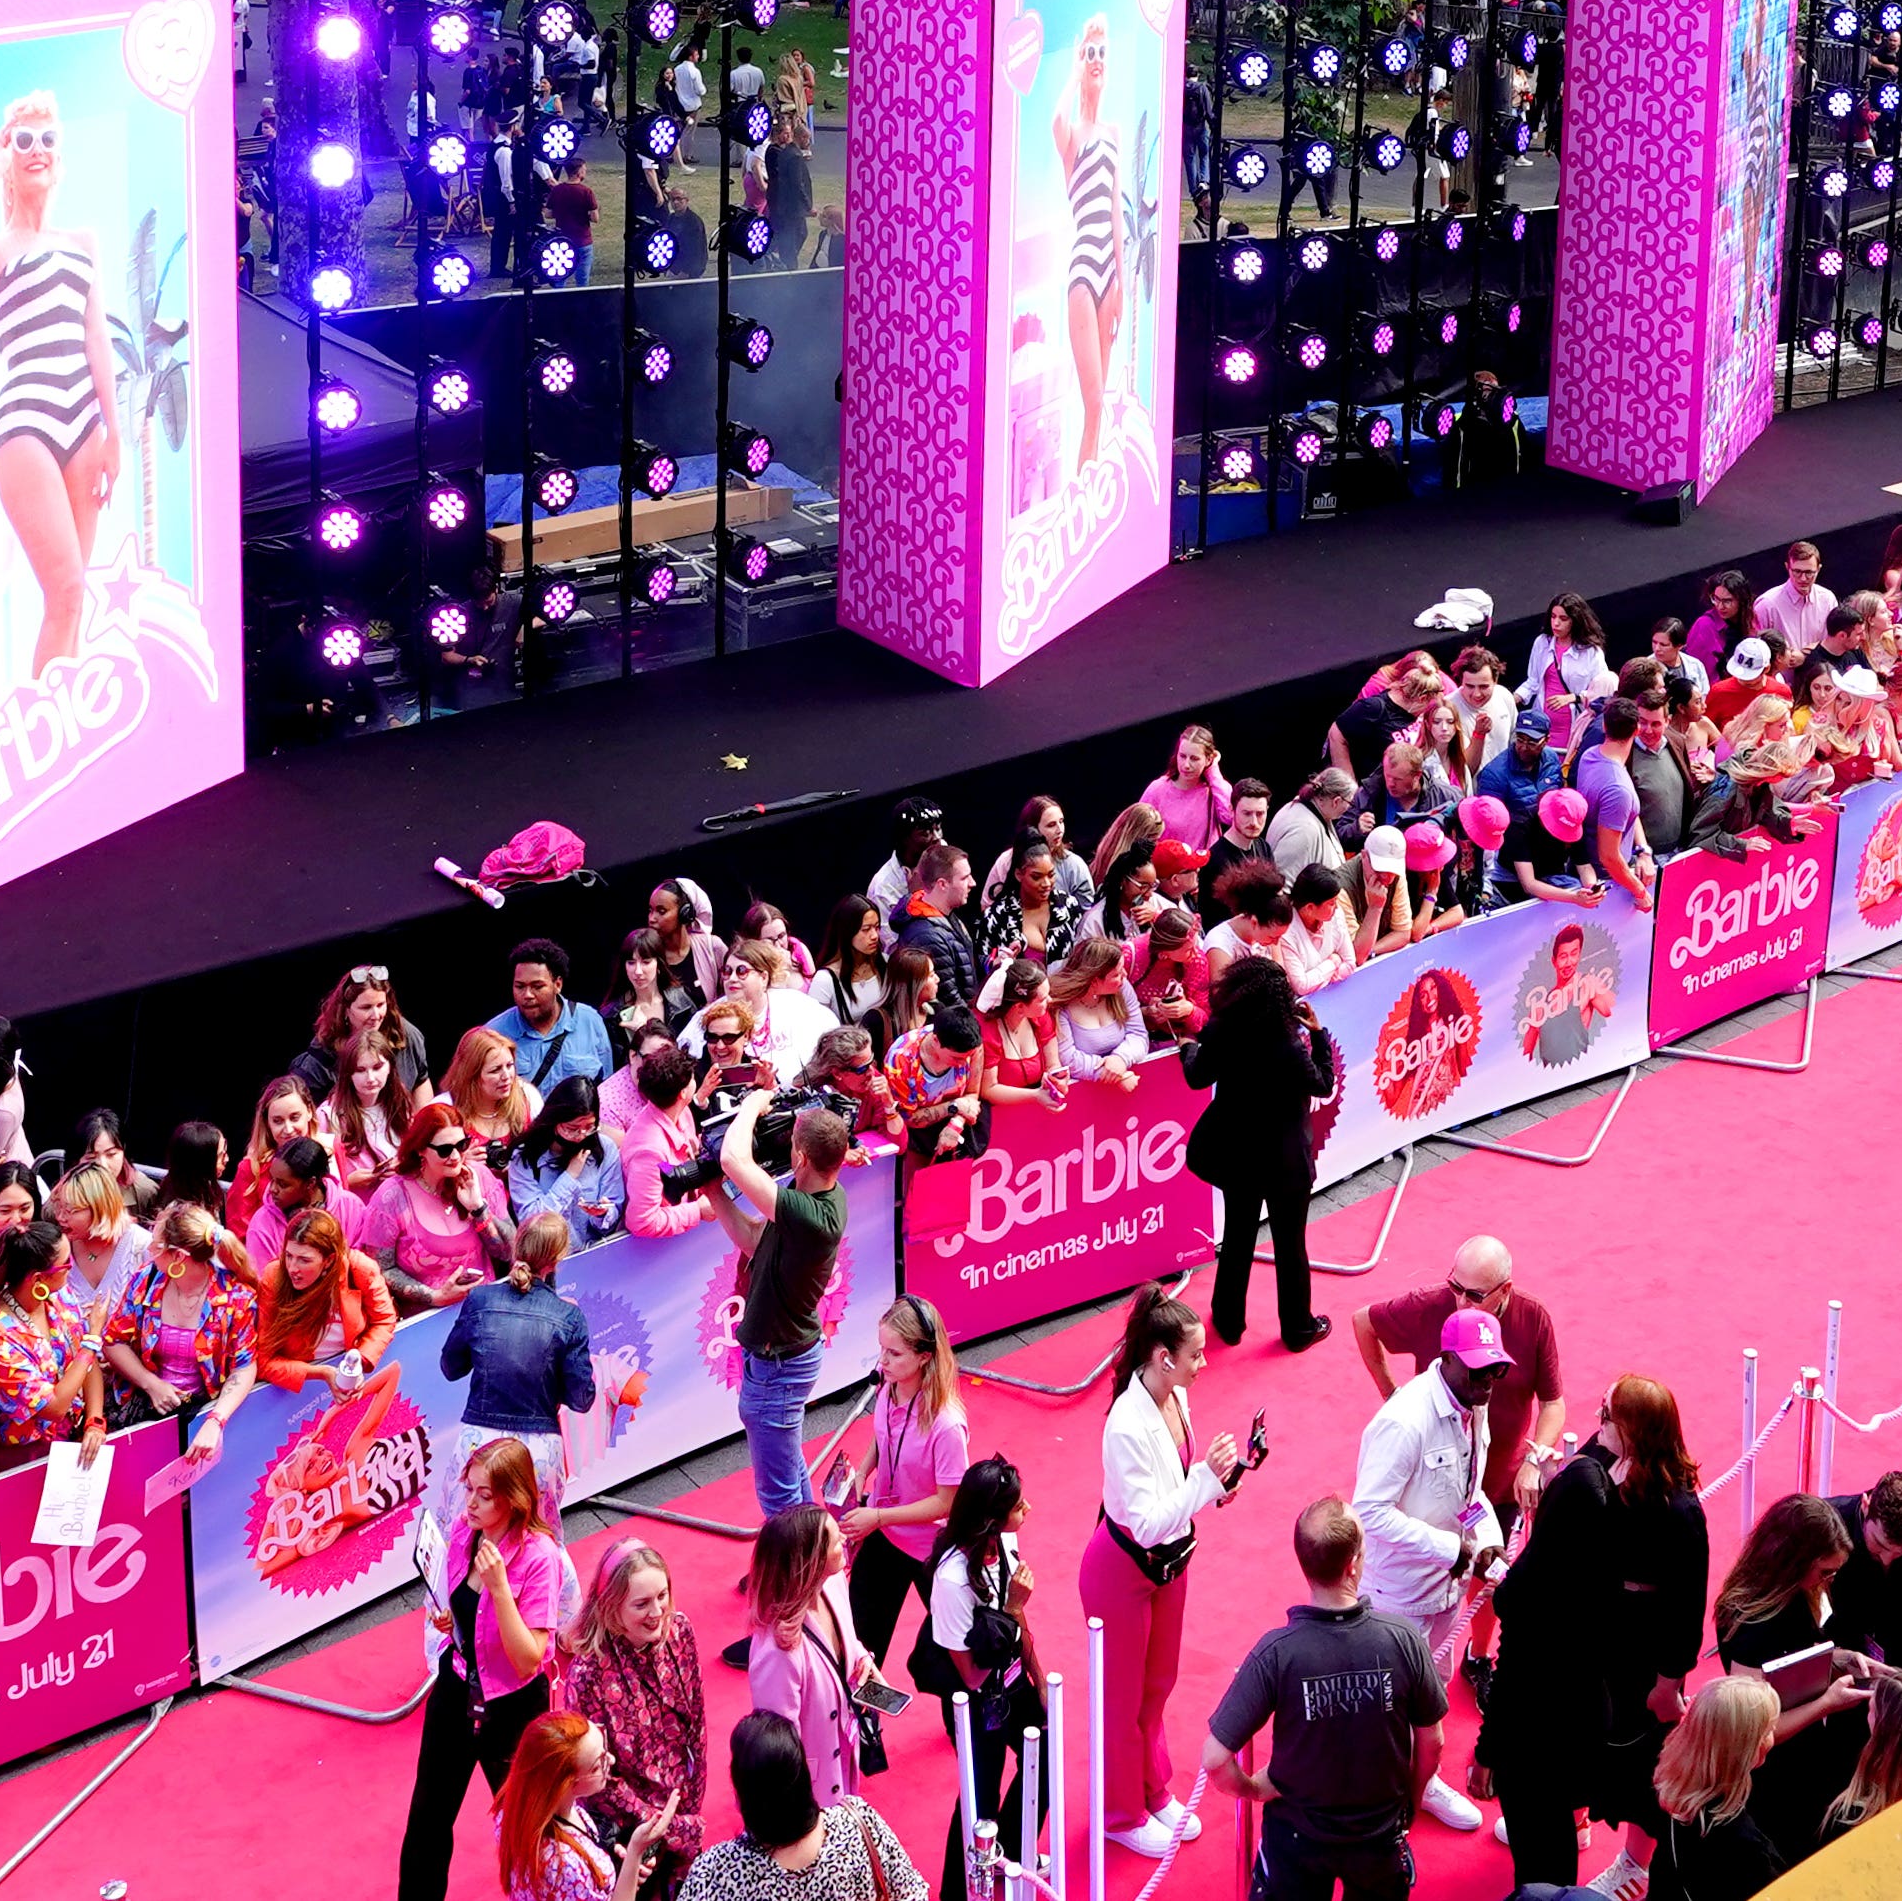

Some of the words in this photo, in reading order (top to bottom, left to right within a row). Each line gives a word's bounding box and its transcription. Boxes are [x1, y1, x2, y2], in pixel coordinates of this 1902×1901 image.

[1000, 459, 1118, 645] Barbie
[1669, 854, 1821, 971] Barbie
[1681, 972, 1700, 995] In
[1700, 949, 1759, 987] cinemas
[1759, 932, 1788, 966] July
[1787, 925, 1804, 955] 21
[1516, 965, 1614, 1036] Barbie
[1378, 1012, 1475, 1091] Barbie
[937, 1115, 1187, 1259] Barbie
[960, 1245, 990, 1290] In
[991, 1233, 1090, 1281] cinemas
[1092, 1210, 1140, 1252] July
[1141, 1203, 1165, 1236] 21
[59, 1472, 94, 1541] Barbie!
[256, 1440, 420, 1563] Barbie
[6, 1645, 76, 1701] July
[81, 1628, 116, 1670] 21
[1302, 1674, 1379, 1697] LIMITED
[1304, 1687, 1375, 1710] EDITION
[1305, 1700, 1361, 1722] EVENT
